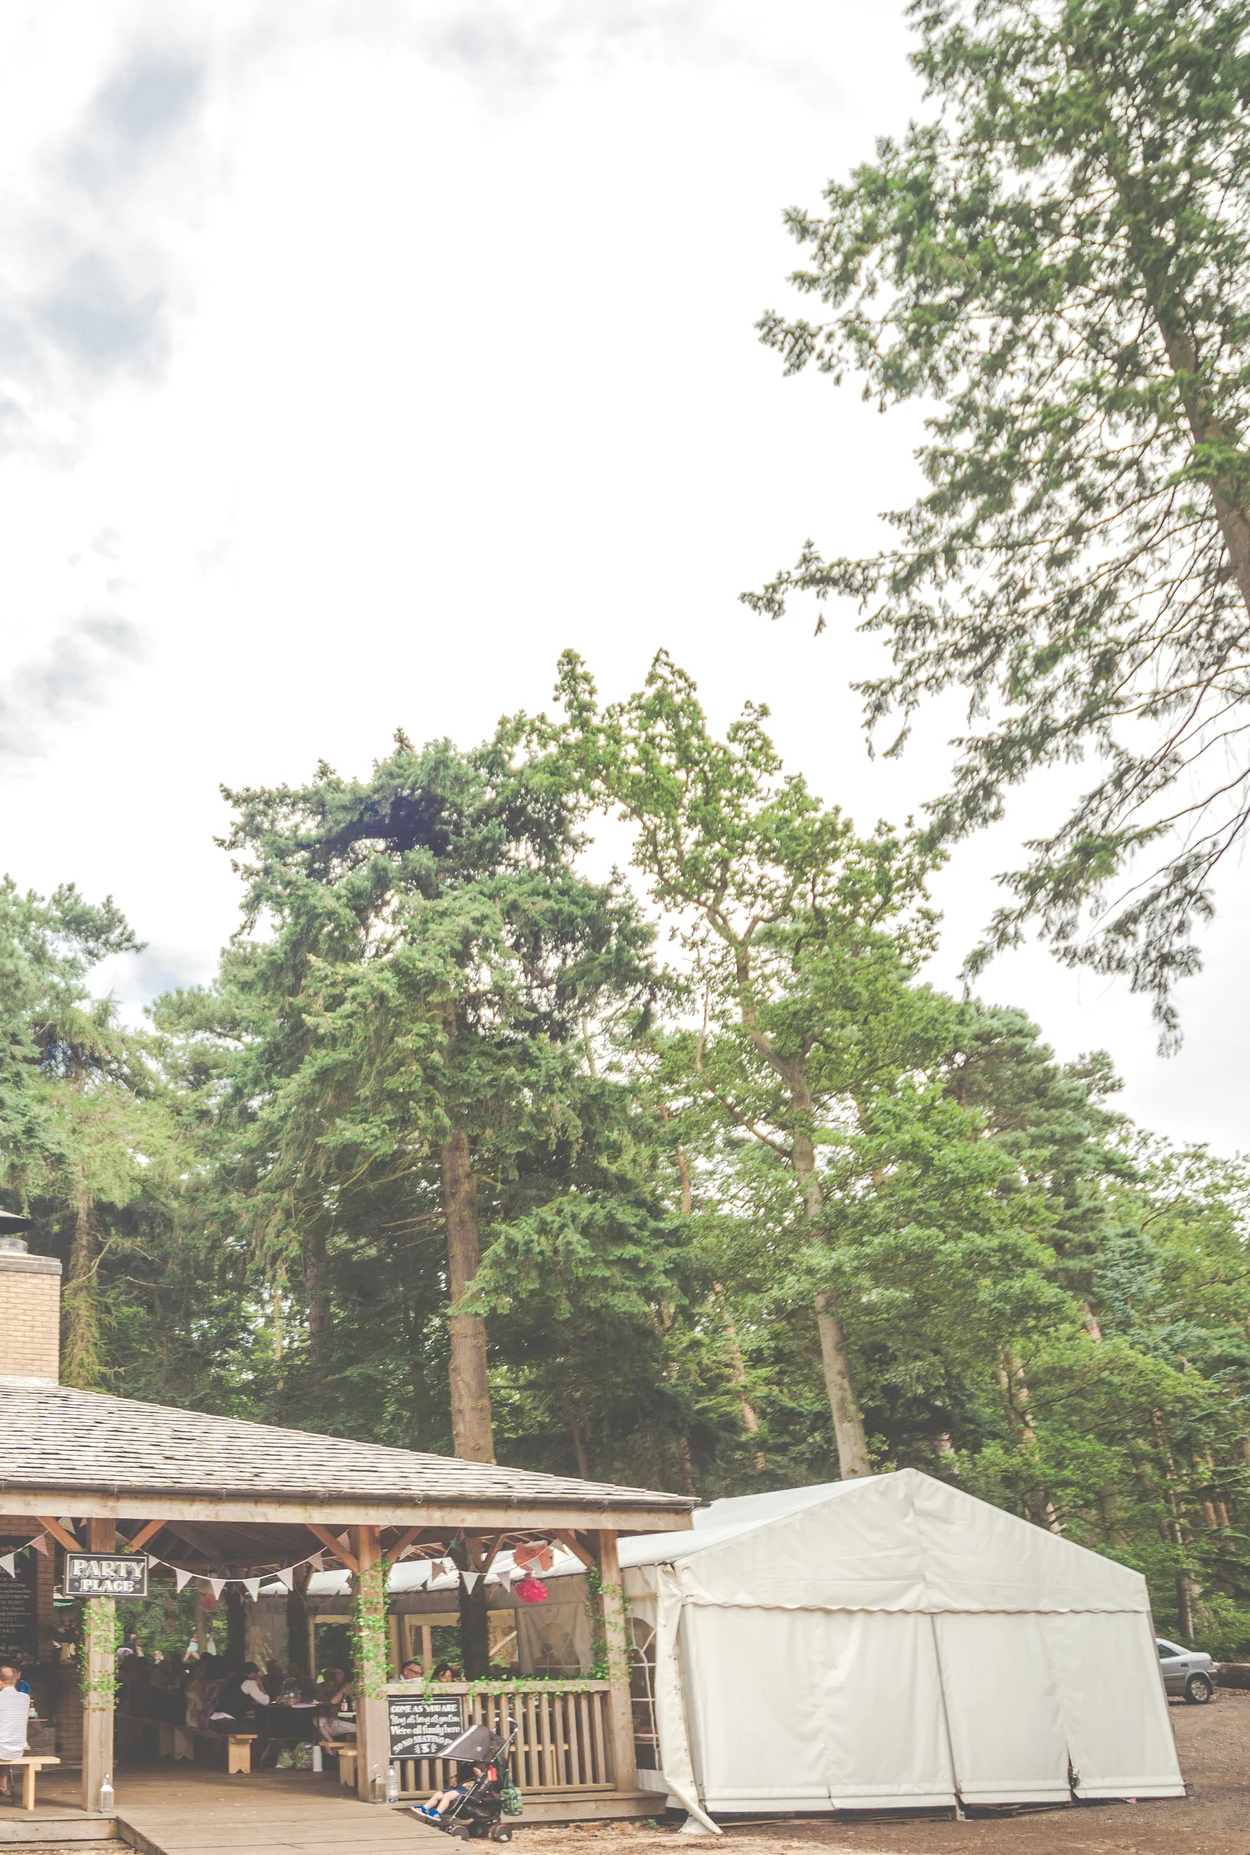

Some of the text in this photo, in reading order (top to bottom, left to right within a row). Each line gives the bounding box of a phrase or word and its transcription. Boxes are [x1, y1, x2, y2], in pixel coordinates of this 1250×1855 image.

[69, 1559, 145, 1580] PARTY
[79, 1578, 135, 1593] PLACE
[390, 1704, 458, 1713] COME AS YOU ARE
[413, 1725, 422, 1734] all
[422, 1724, 445, 1736] family
[444, 1724, 461, 1734] here
[413, 1734, 445, 1744] SEATING
